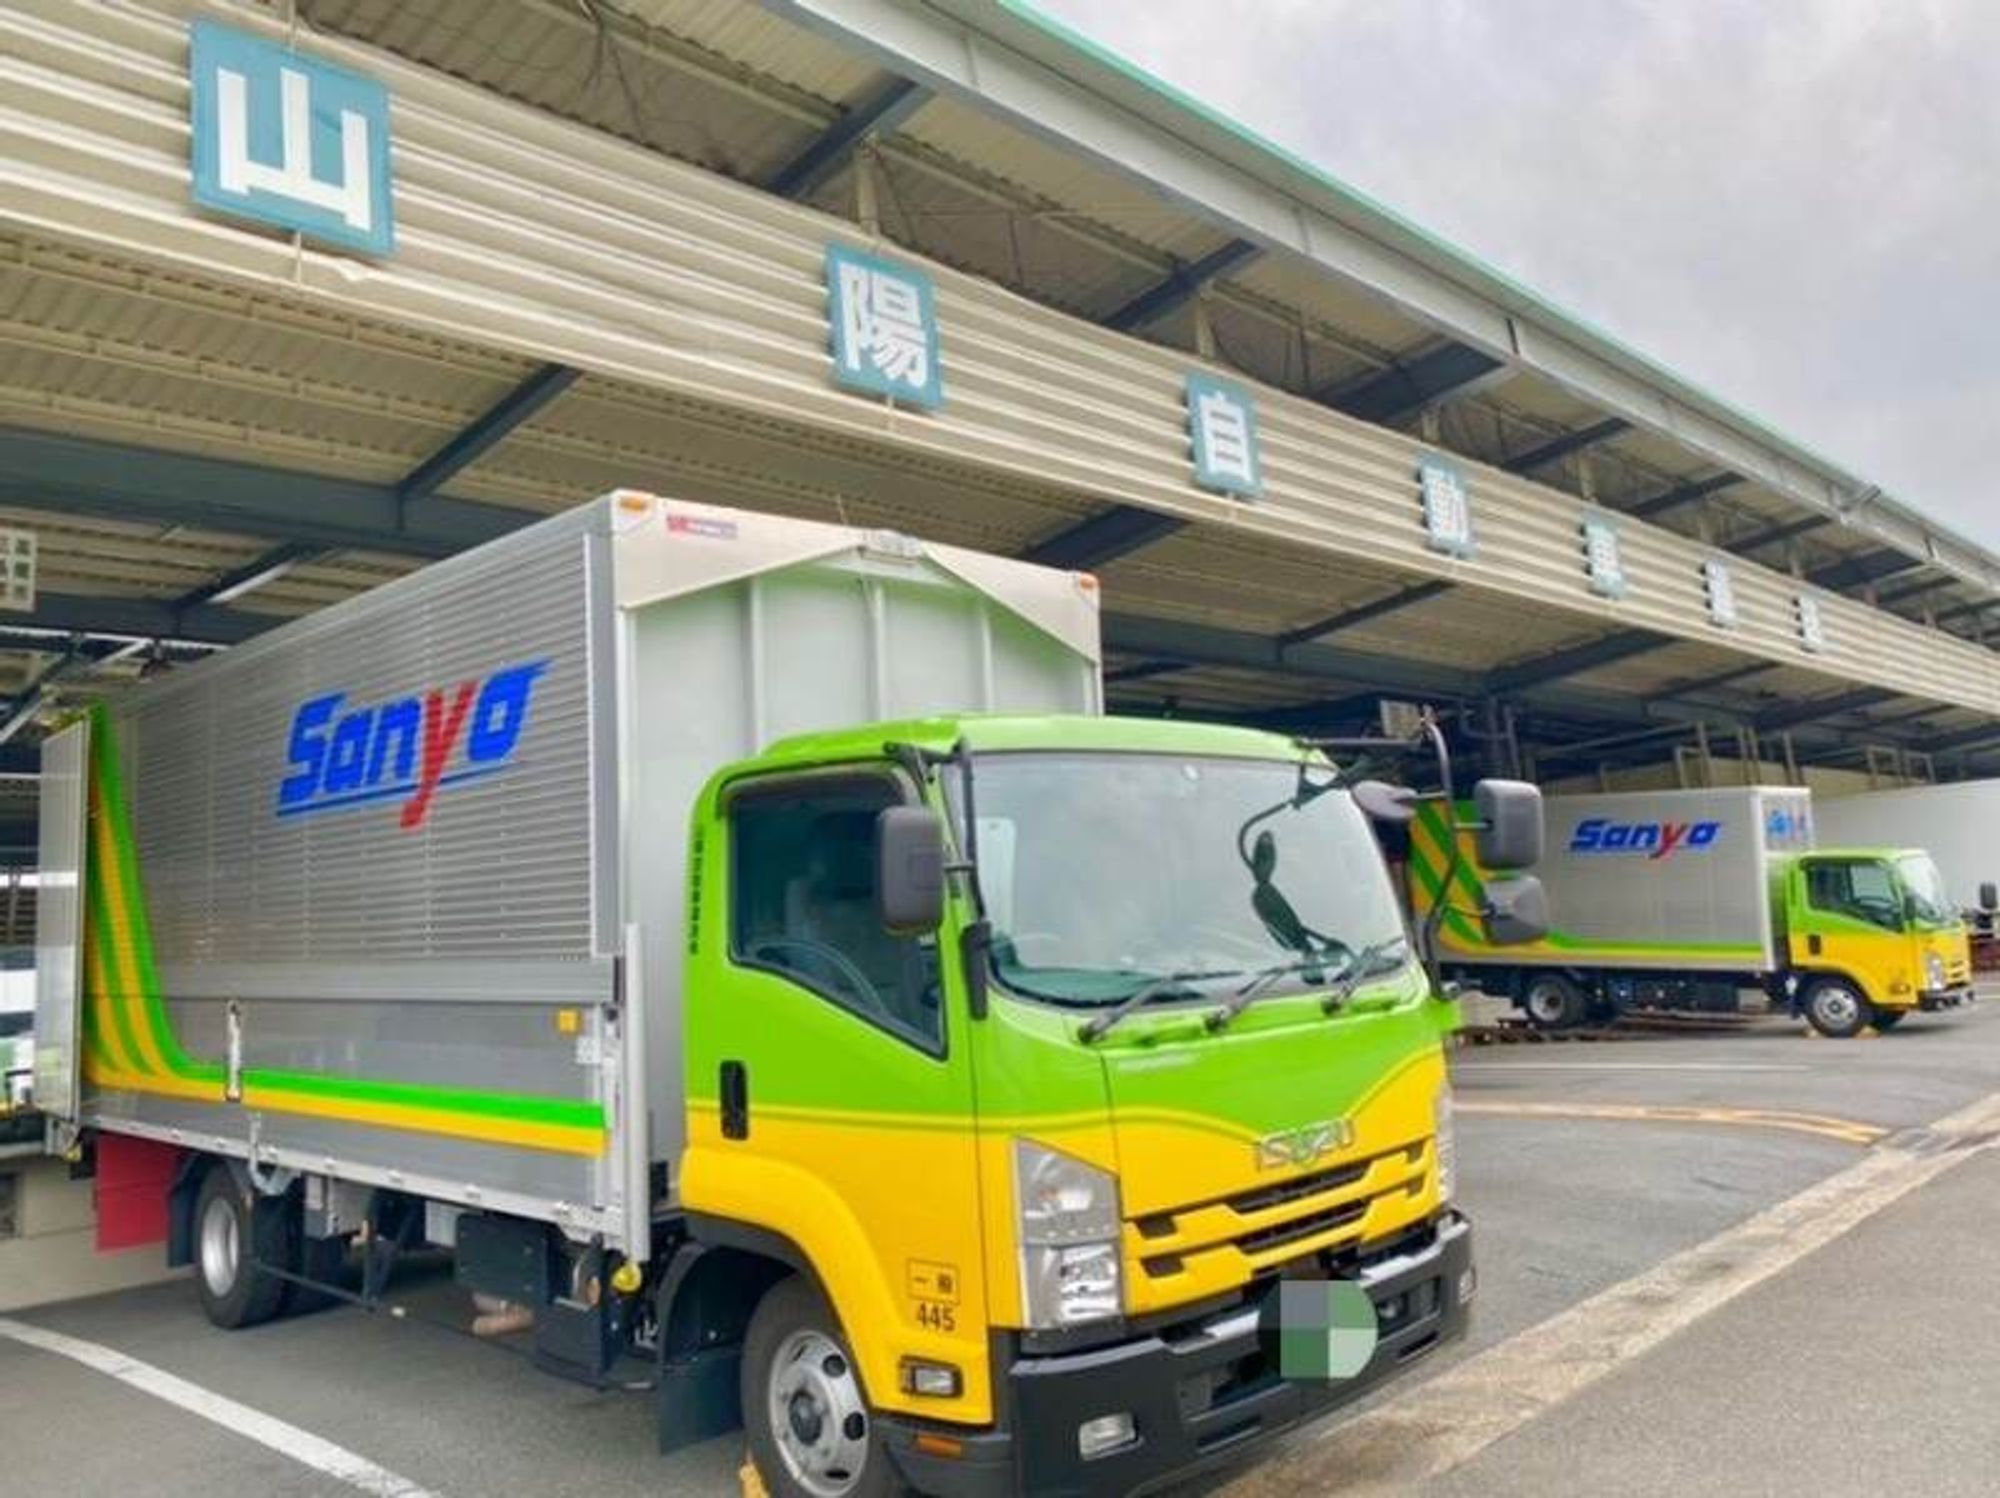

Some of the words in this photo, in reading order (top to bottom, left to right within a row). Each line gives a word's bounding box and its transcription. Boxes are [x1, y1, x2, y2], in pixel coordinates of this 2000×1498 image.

[217, 66, 371, 231] 山
[840, 261, 928, 388] 陽
[1199, 390, 1252, 482] 自
[277, 656, 554, 829] Sanyo
[1570, 818, 1722, 860] Sanyo
[915, 1301, 956, 1332] 445
